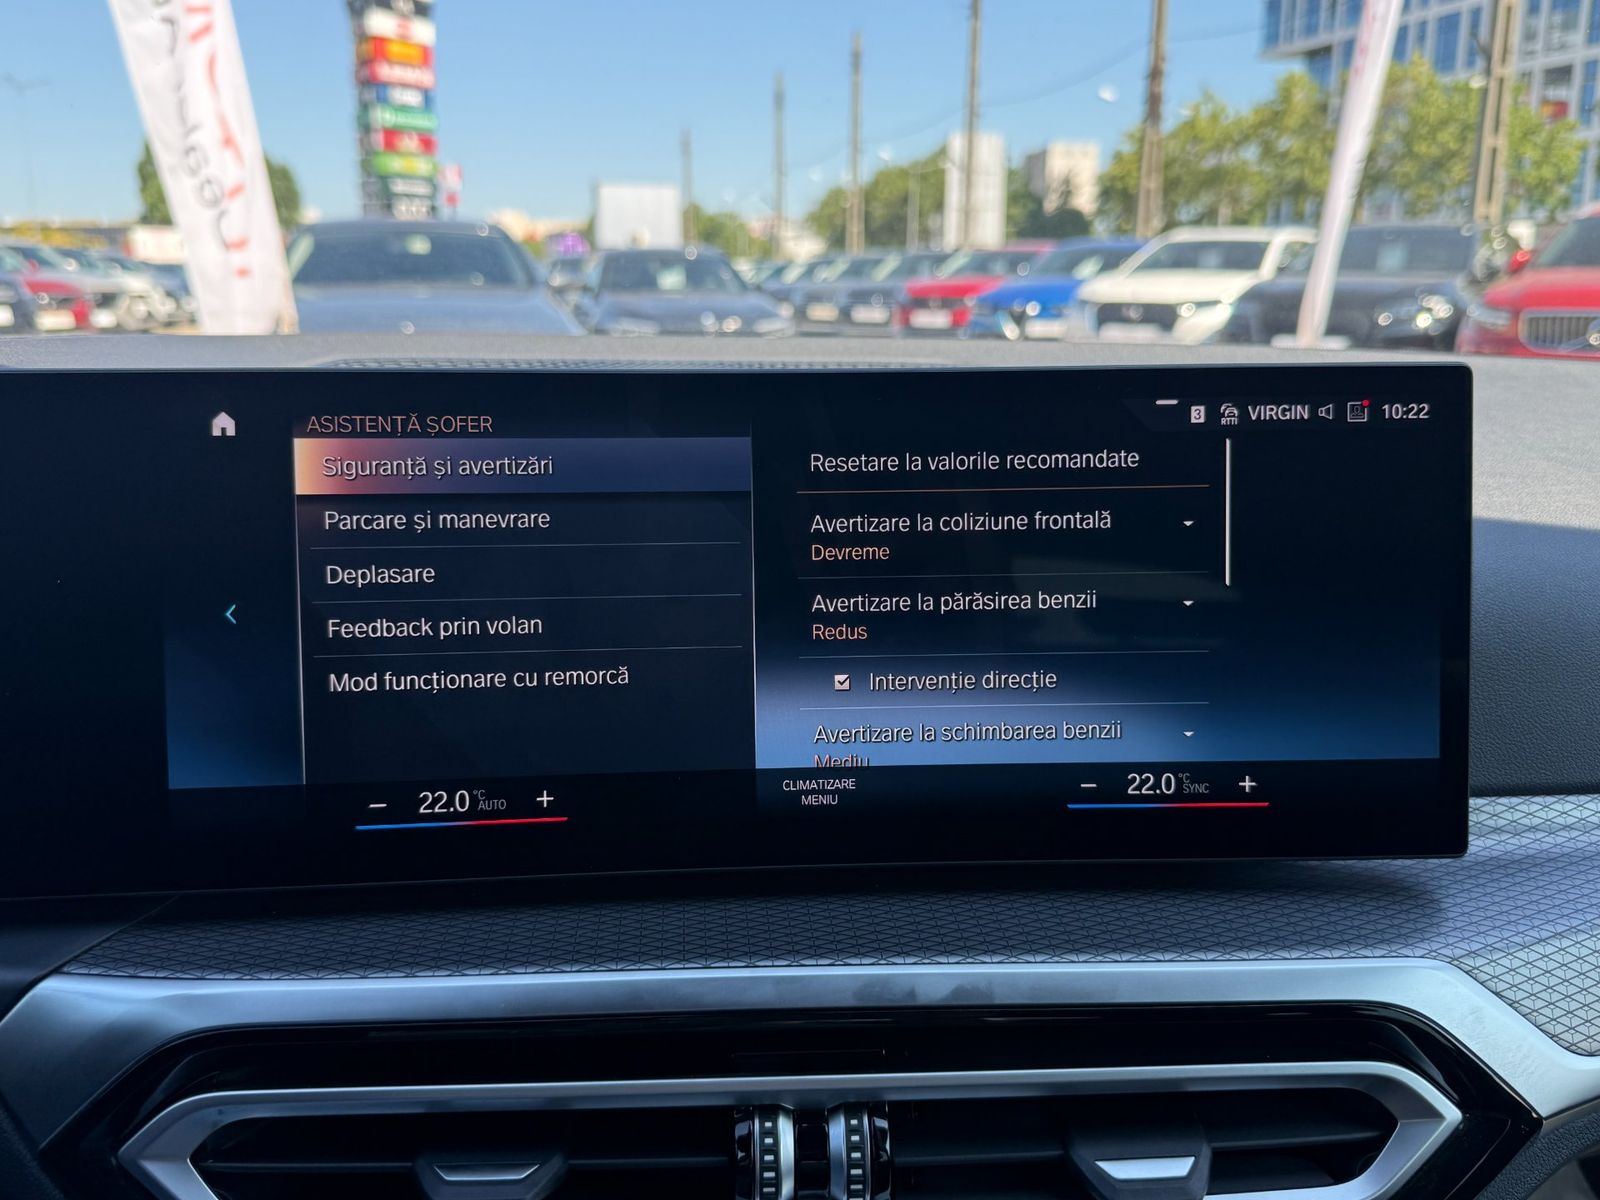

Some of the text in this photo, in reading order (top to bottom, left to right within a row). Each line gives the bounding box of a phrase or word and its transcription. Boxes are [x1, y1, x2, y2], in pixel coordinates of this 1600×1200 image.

[1192, 407, 1203, 421] 3
[1220, 417, 1238, 426] RTTI
[1247, 404, 1309, 421] VIRGIN
[1382, 403, 1429, 420] 10:22
[306, 412, 493, 437] ASISTENȚĂ ȘOFER
[321, 455, 553, 480] Siguranță și avertizări
[810, 449, 1140, 473] Resetare la valorile recomandate
[324, 510, 550, 534] Parcare și manevrare
[810, 510, 1111, 533] Avertizare la coliziune frontală
[811, 544, 890, 561] Devreme
[326, 564, 436, 588] Deplasare
[811, 589, 1096, 615] Avertizare la părăsirea benzii
[328, 615, 542, 640] Feedback prin volan
[812, 623, 868, 640] Redus
[329, 665, 629, 694] Mod funcționare cu remorcă
[870, 669, 1057, 694] Intervenție direcție
[813, 719, 1122, 744] Avertizare la schimbarea benzii
[782, 778, 856, 791] CLIMATIZARE
[1127, 772, 1176, 795] 22.0
[1182, 782, 1210, 794] SYNC
[419, 789, 470, 814] 22.0
[477, 798, 507, 811] AUTO
[801, 793, 838, 806] MENIU
